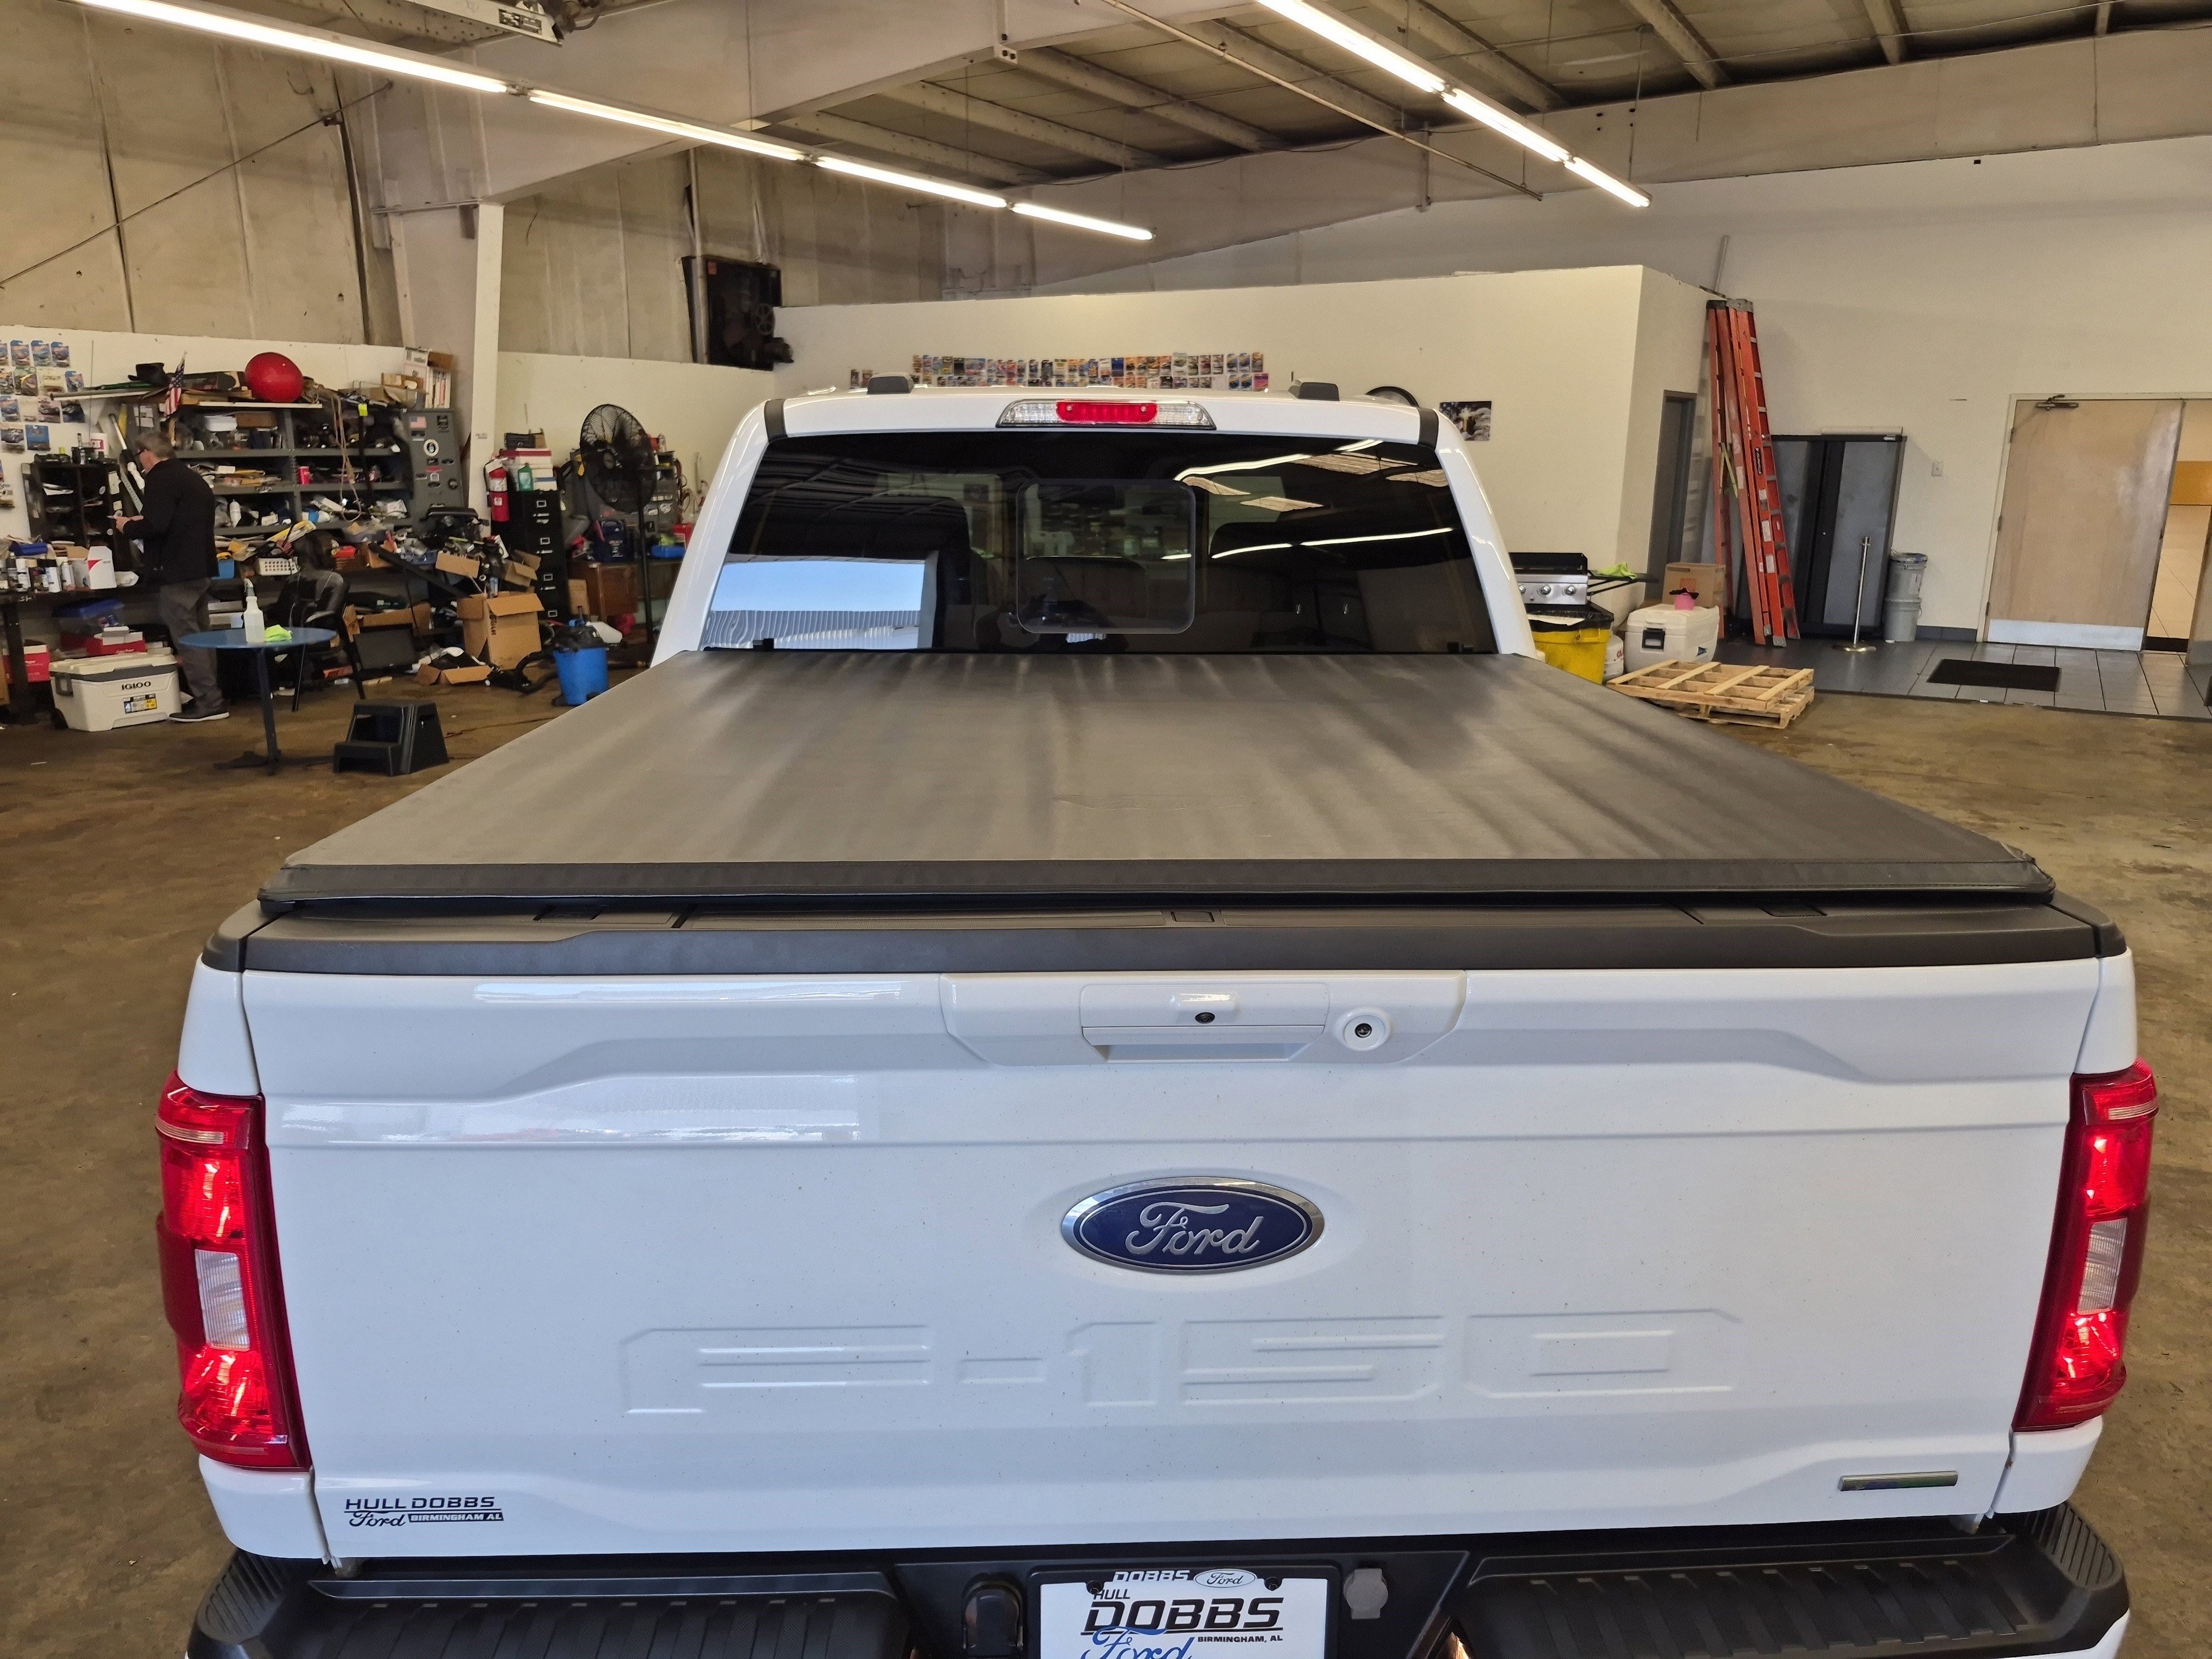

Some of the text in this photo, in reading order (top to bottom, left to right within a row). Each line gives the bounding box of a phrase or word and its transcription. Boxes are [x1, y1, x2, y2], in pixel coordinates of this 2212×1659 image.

[121, 681, 151, 690] IGLOO
[1125, 1201, 1264, 1256] Ford
[619, 1308, 1744, 1413] F-150
[345, 1496, 495, 1510] HULL DOBBS
[349, 1510, 502, 1527] Ford BIRMINGHAM AL
[1113, 1570, 1190, 1582] DOBBS
[1206, 1572, 1244, 1585] Ford
[1093, 1589, 1130, 1600] HULL
[1084, 1597, 1284, 1631] DOBBS
